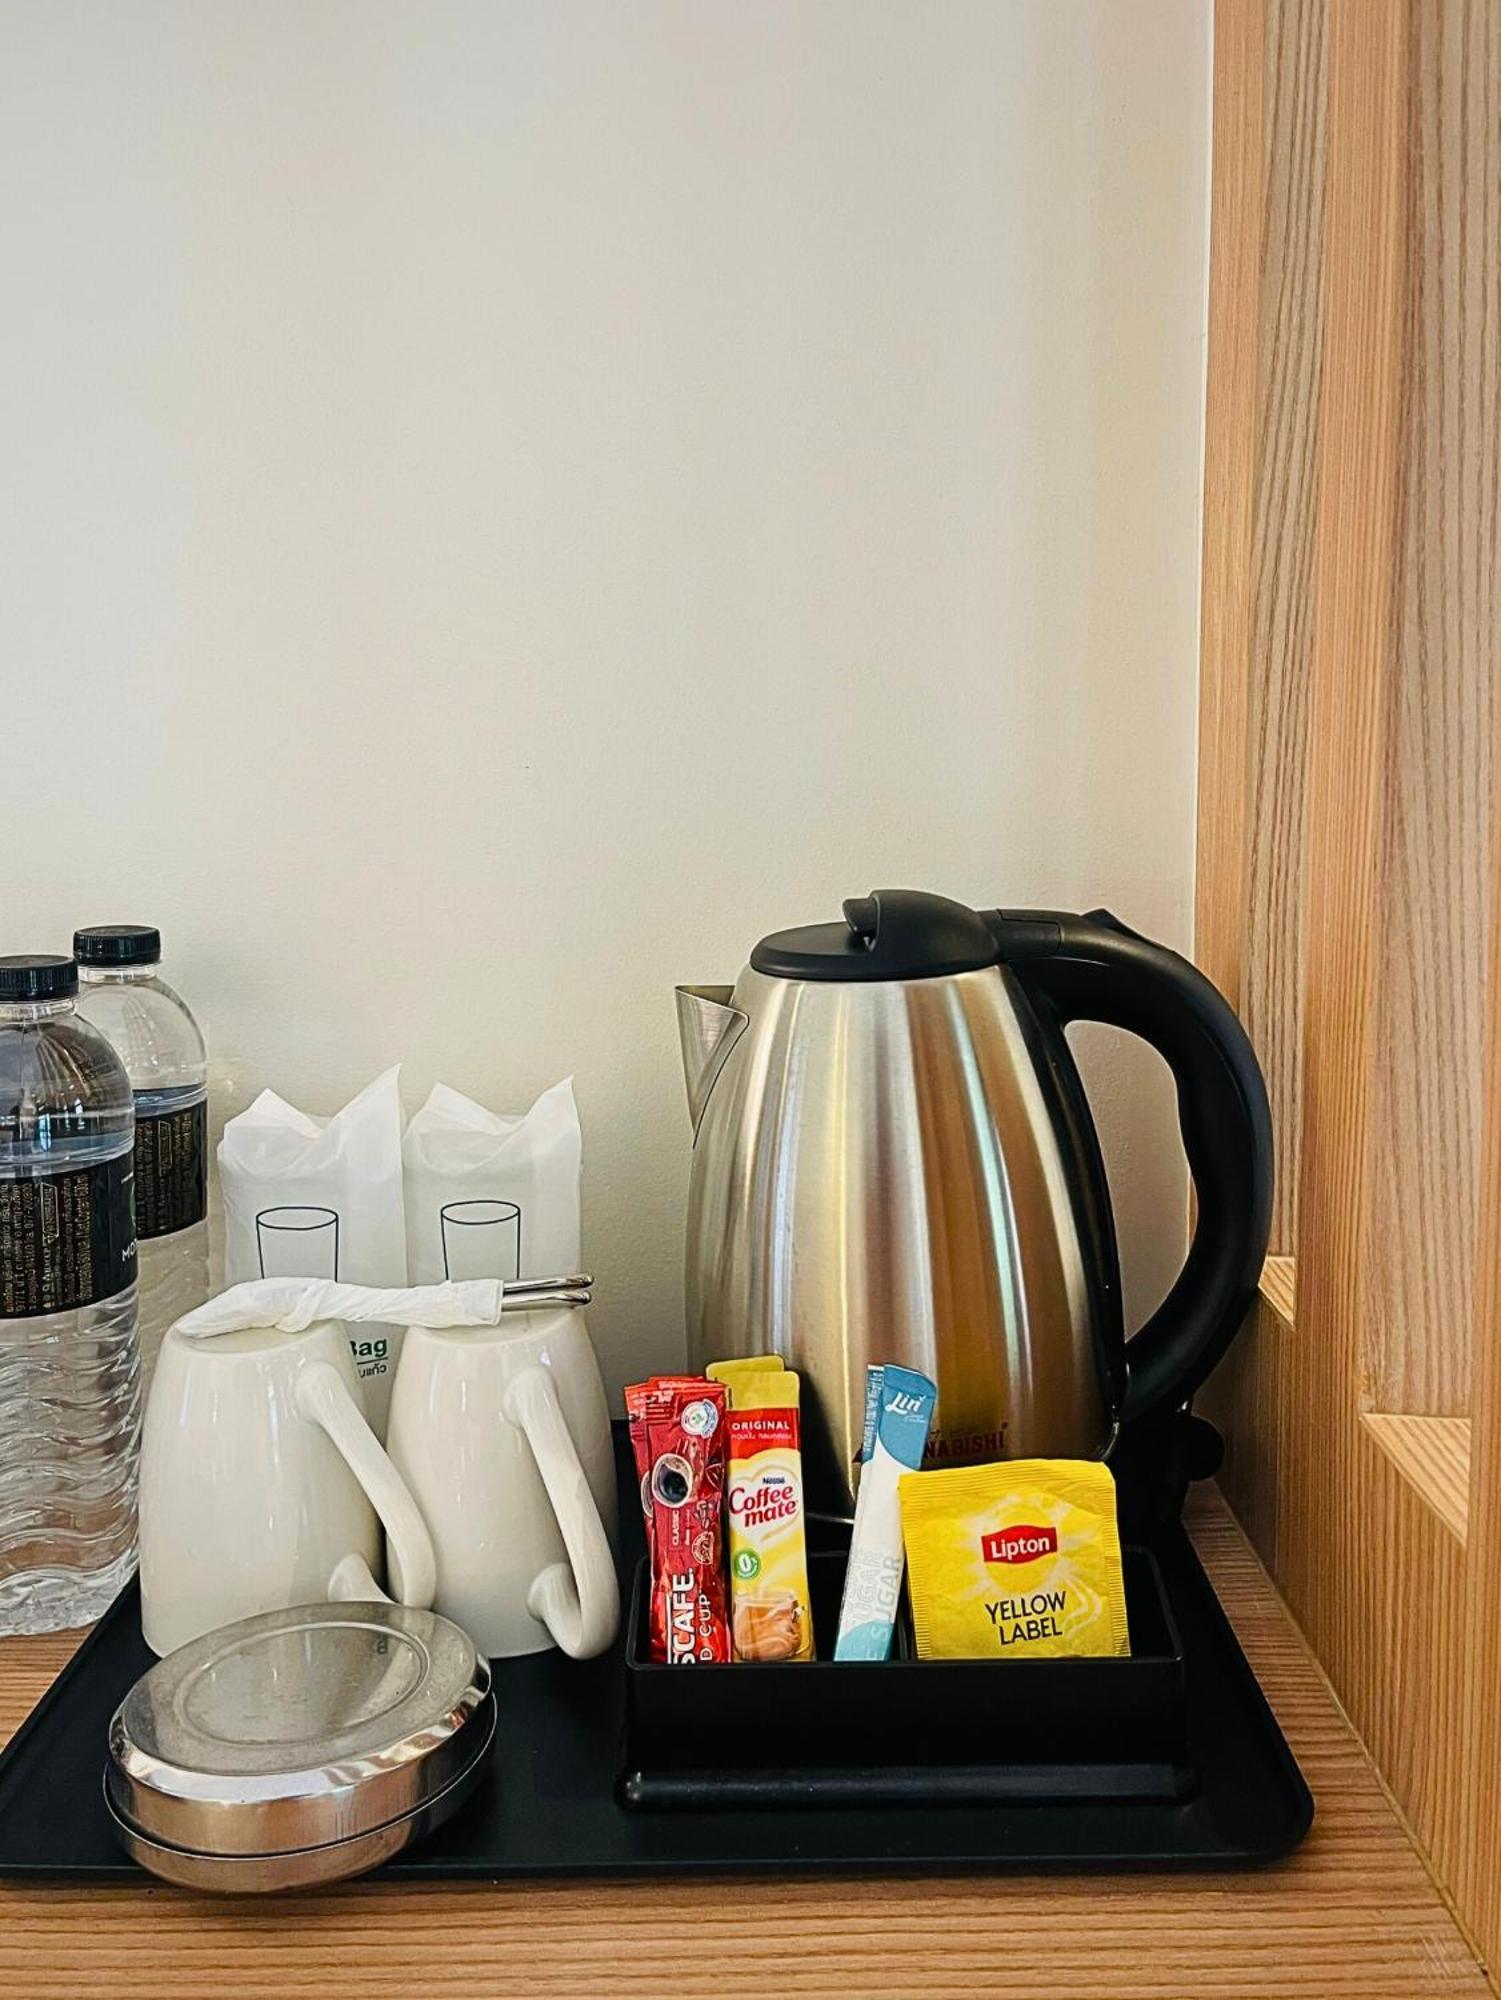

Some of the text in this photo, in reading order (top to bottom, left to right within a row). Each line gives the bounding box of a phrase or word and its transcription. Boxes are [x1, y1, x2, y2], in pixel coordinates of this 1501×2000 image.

[121, 1238, 137, 1262] MO
[731, 1420, 790, 1431] ORIGINAL
[925, 1430, 1005, 1459] NABISHI
[728, 1485, 794, 1516] Coffee
[744, 1500, 797, 1528] mate
[990, 1536, 1051, 1561] Lipton
[698, 1593, 712, 1638] CUP
[984, 1590, 1067, 1625] YELLOW
[998, 1616, 1064, 1647] LABEL
